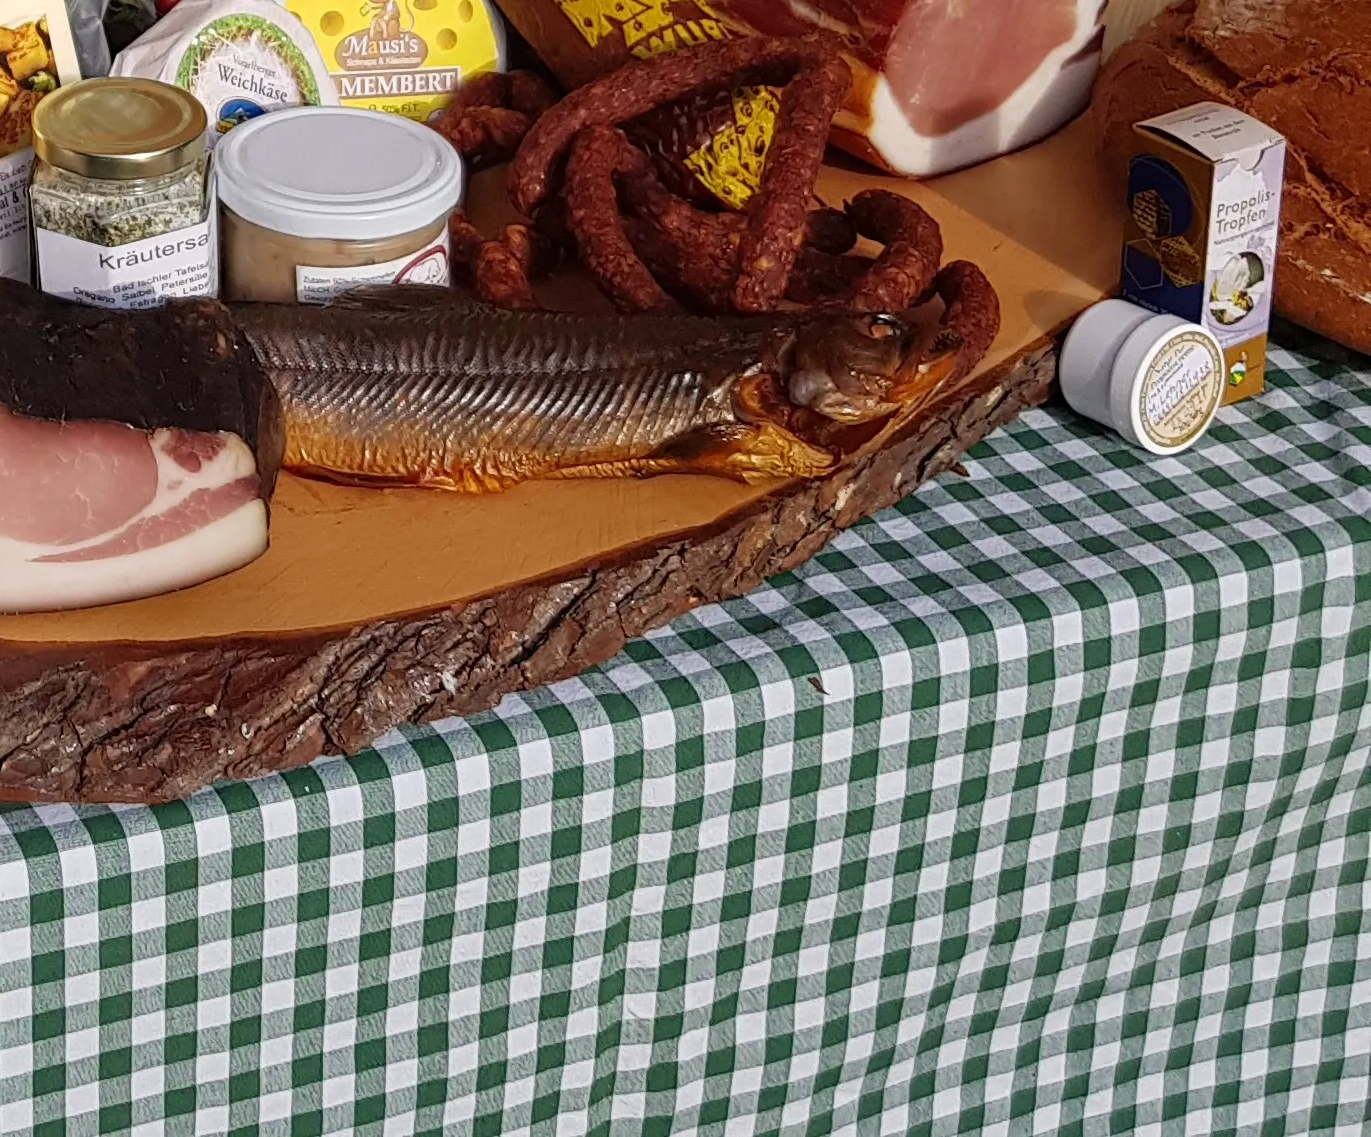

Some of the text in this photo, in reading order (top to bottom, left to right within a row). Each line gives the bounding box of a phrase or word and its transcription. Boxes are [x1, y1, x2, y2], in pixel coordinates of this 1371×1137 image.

[217, 63, 288, 103] Weichkäse
[340, 71, 456, 96] MEMBERT
[1216, 189, 1276, 218] Propolis-
[1216, 208, 1266, 235] Tropfen
[98, 233, 209, 270] Kräutersa
[113, 282, 134, 293] Bad
[137, 272, 172, 287] Ischler
